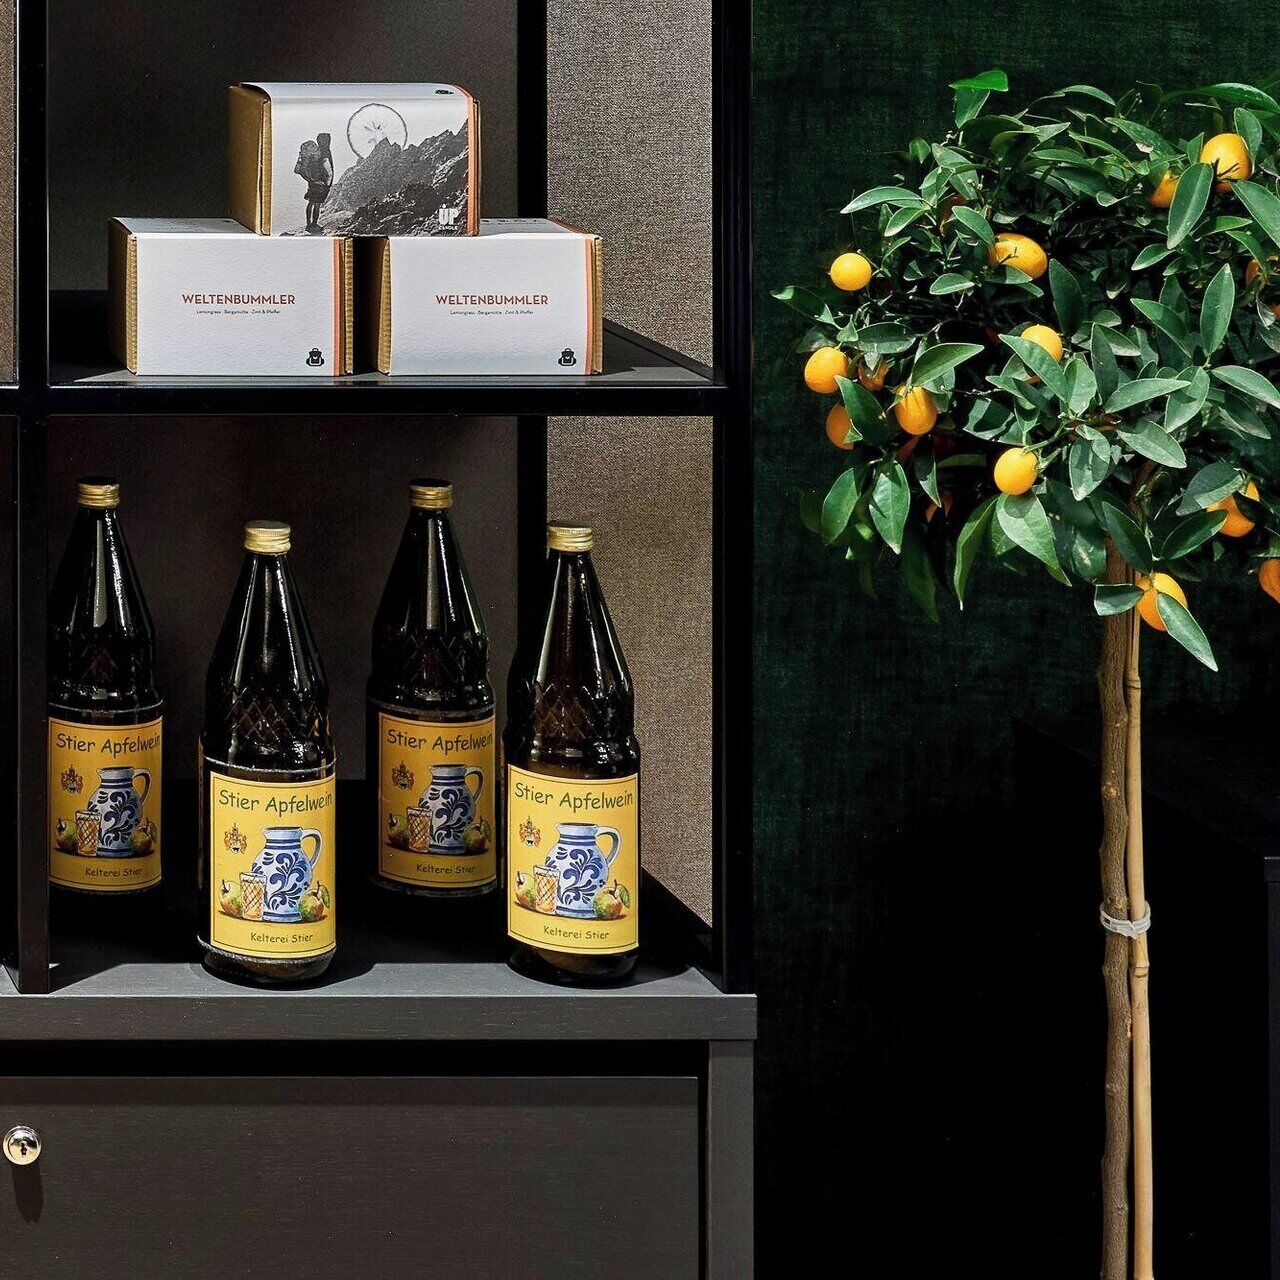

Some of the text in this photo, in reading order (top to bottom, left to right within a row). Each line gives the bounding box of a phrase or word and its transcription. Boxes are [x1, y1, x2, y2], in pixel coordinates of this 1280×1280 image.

[182, 294, 296, 305] WELTENBUMMLER
[435, 294, 549, 305] WELTENBUMMLER
[55, 732, 161, 758] Stier Apfelwein
[387, 728, 427, 749] Stier
[219, 789, 333, 818] Stier Apfelwein
[514, 782, 634, 813] Stier Apfelwein
[250, 932, 314, 944] Kelterei Stier
[543, 925, 610, 940] Kelterei Stier
